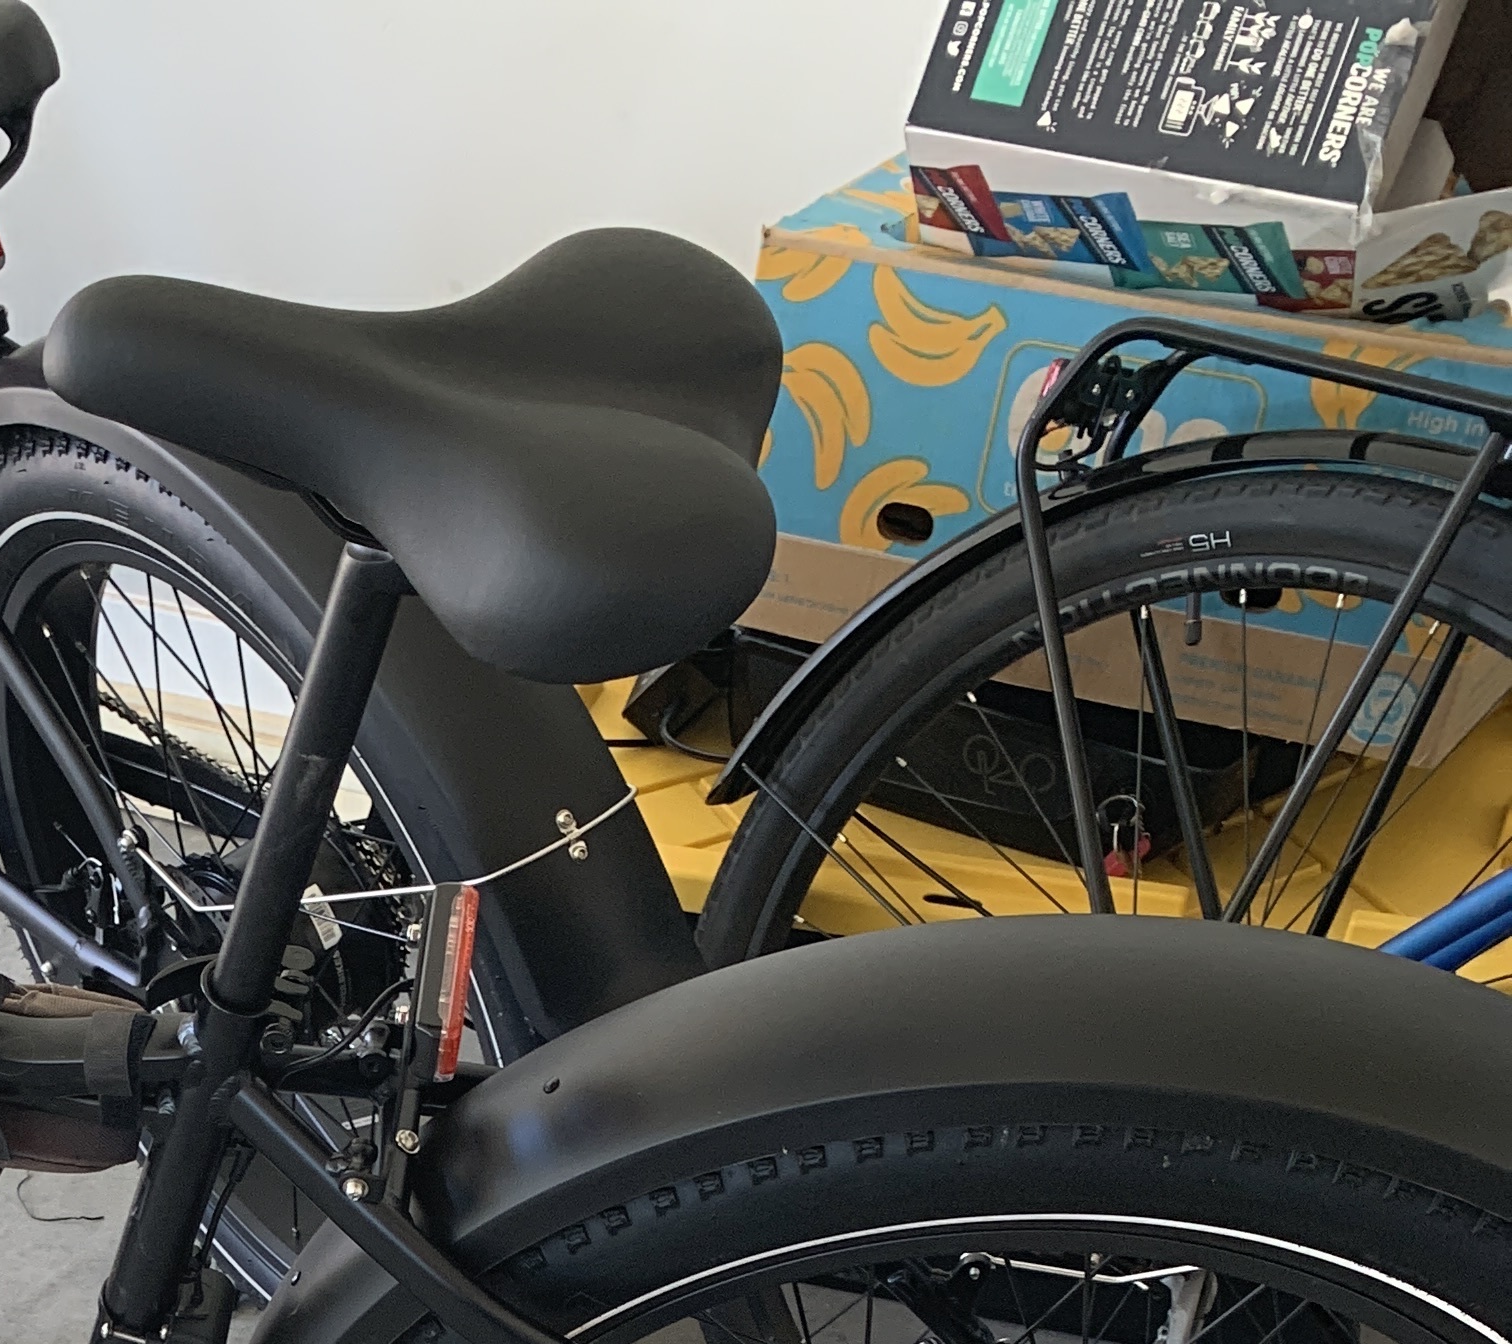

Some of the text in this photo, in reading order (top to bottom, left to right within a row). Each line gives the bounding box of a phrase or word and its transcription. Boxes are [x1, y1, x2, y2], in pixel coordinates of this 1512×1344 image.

[1064, 13, 1083, 44] BETTER
[1222, 5, 1244, 41] FAMILY
[1311, 48, 1323, 61] DO
[1355, 68, 1387, 125] WE ARE
[1407, 408, 1486, 437] High in
[1187, 530, 1231, 552] H5
